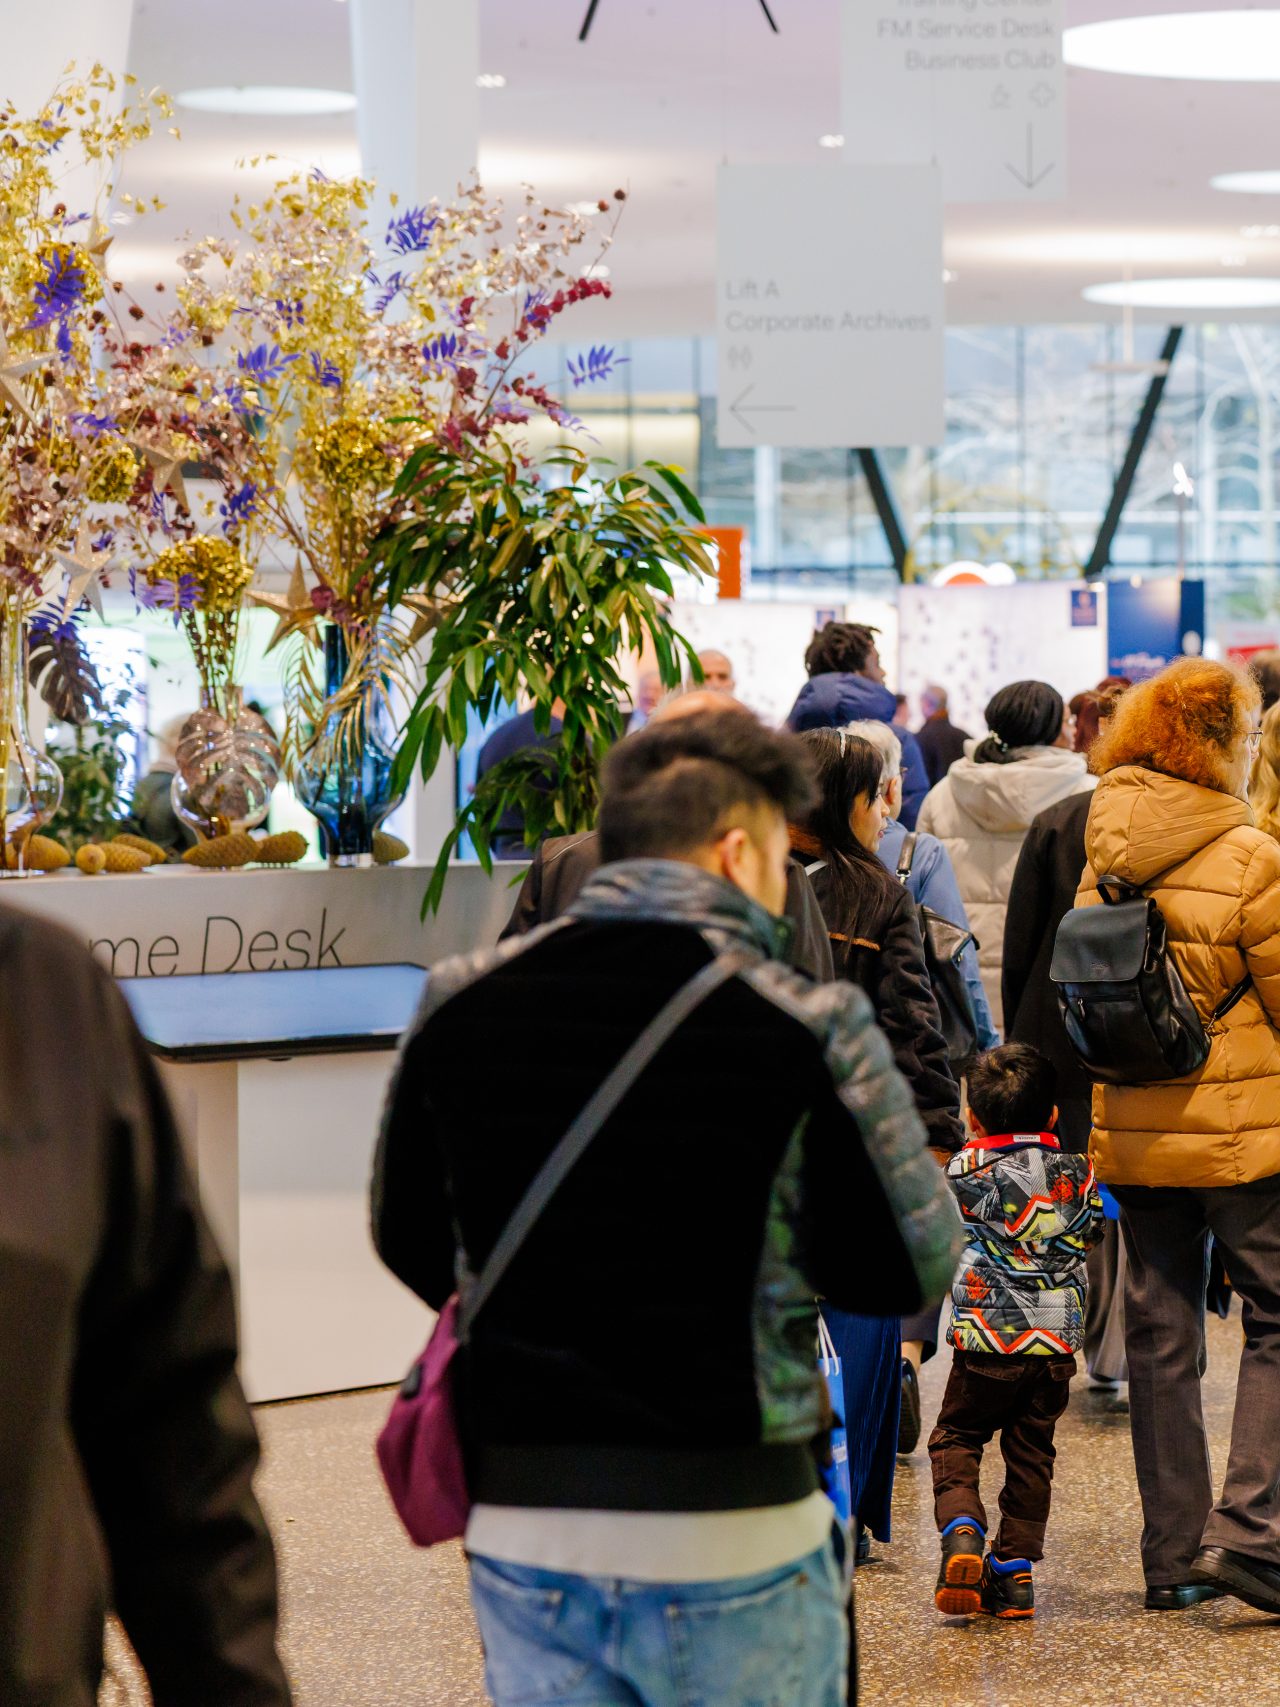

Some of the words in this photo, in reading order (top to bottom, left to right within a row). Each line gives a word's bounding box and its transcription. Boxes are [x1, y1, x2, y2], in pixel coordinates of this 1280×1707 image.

[878, 18, 912, 38] FM
[917, 17, 997, 38] Service
[1001, 18, 1055, 38] Desk
[905, 49, 1000, 70] Business
[1004, 49, 1056, 70] Club
[726, 279, 757, 299] Lift
[765, 280, 780, 298] A
[726, 311, 834, 335] Corporate
[840, 311, 931, 331] Archives
[201, 907, 346, 975] Desk
